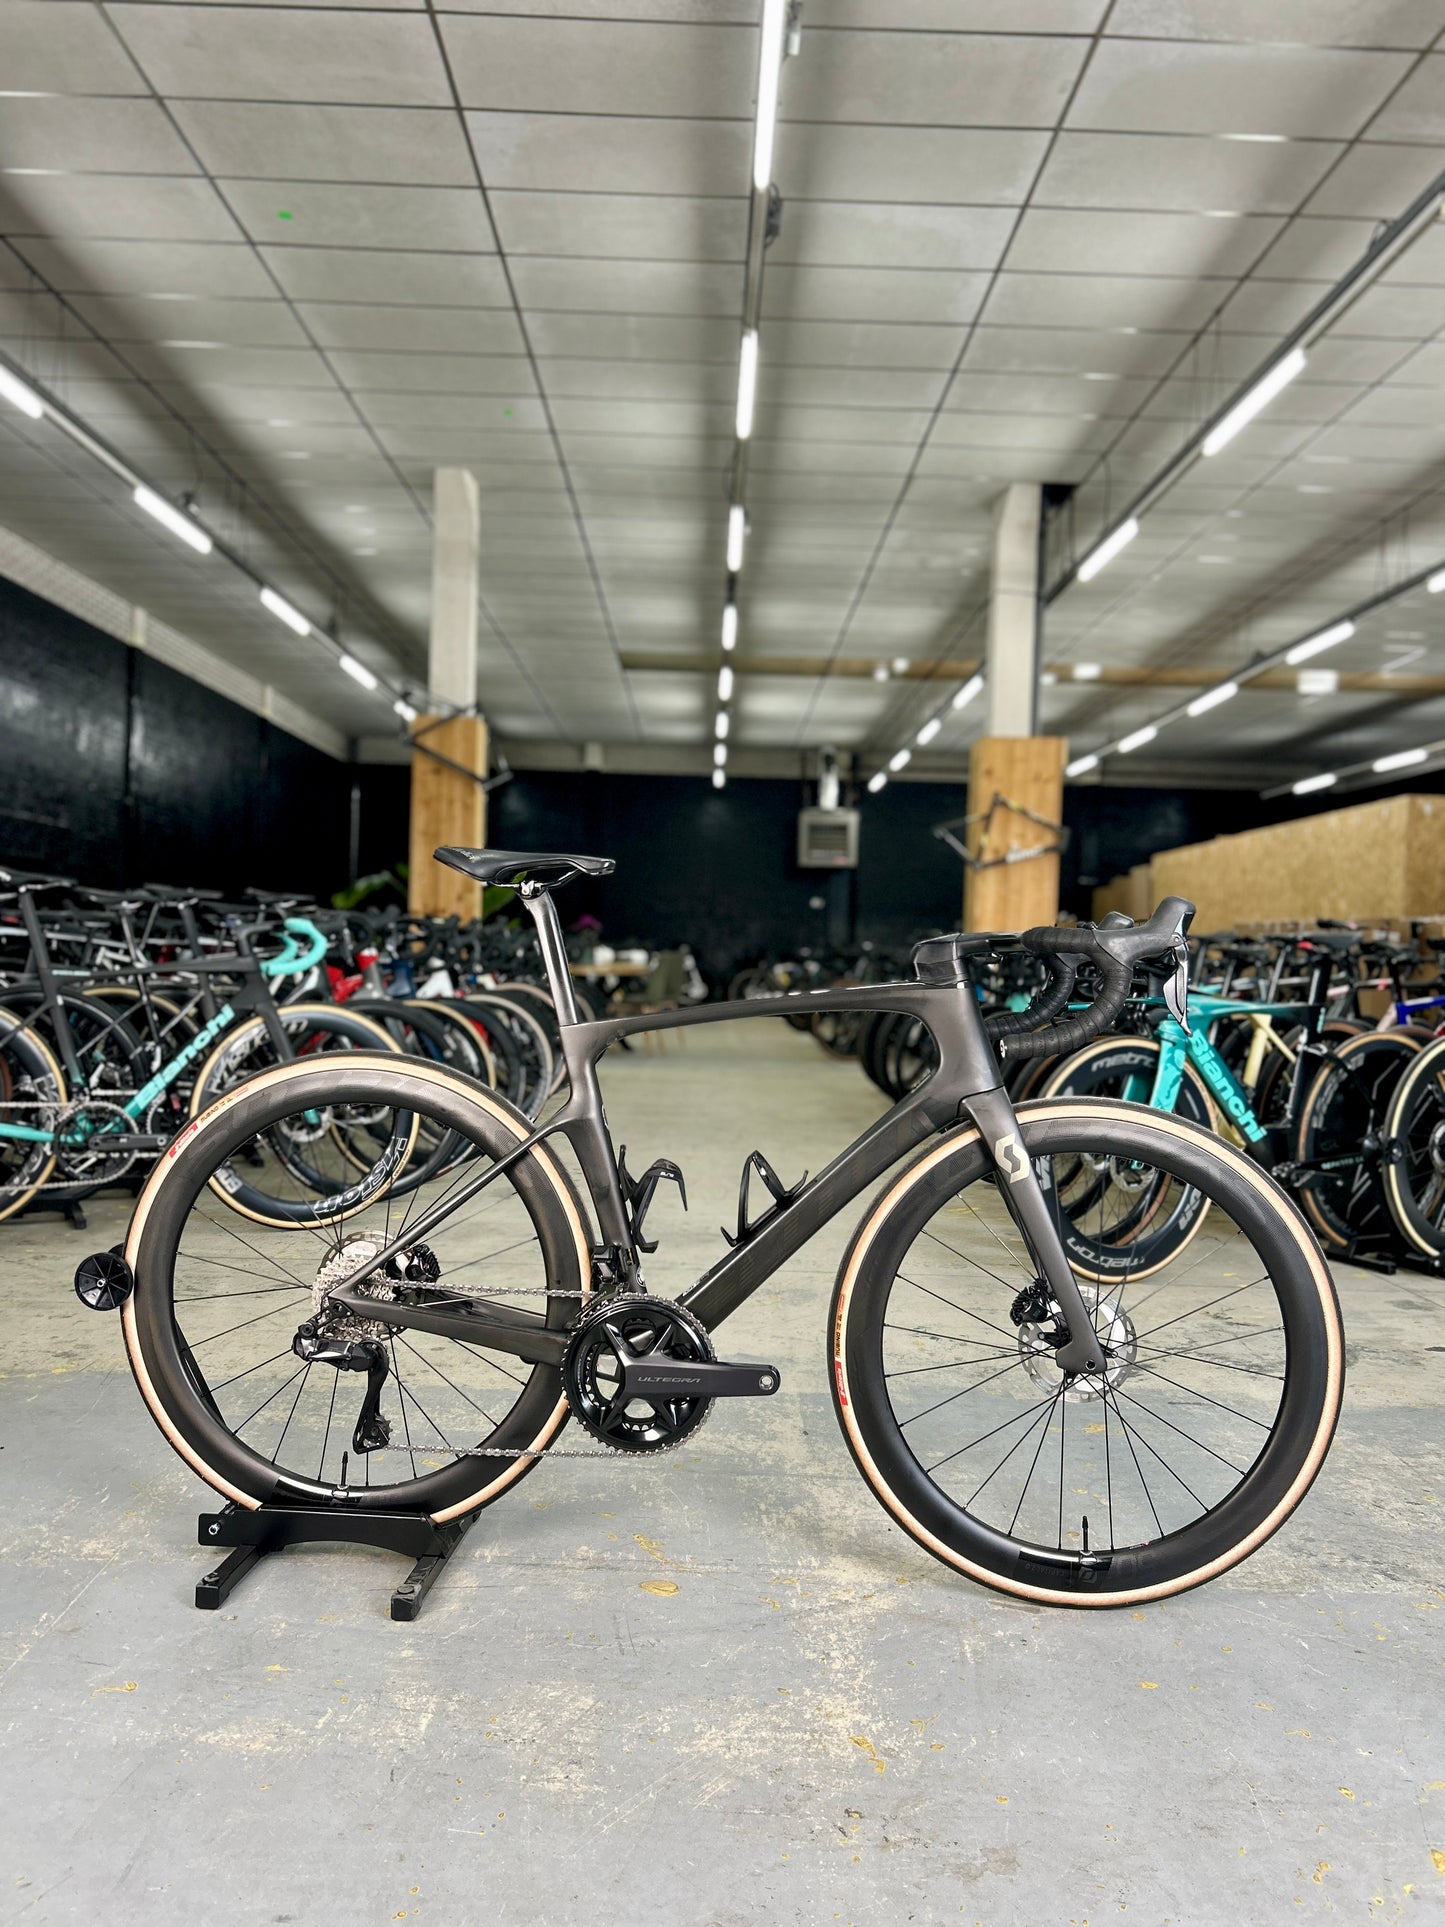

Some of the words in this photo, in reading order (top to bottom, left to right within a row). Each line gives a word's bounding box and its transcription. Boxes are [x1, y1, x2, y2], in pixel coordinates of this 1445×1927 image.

[135, 1003, 235, 1110] Bianchi
[1190, 1029, 1268, 1143] Bianchi
[1066, 1236, 1145, 1268] metron
